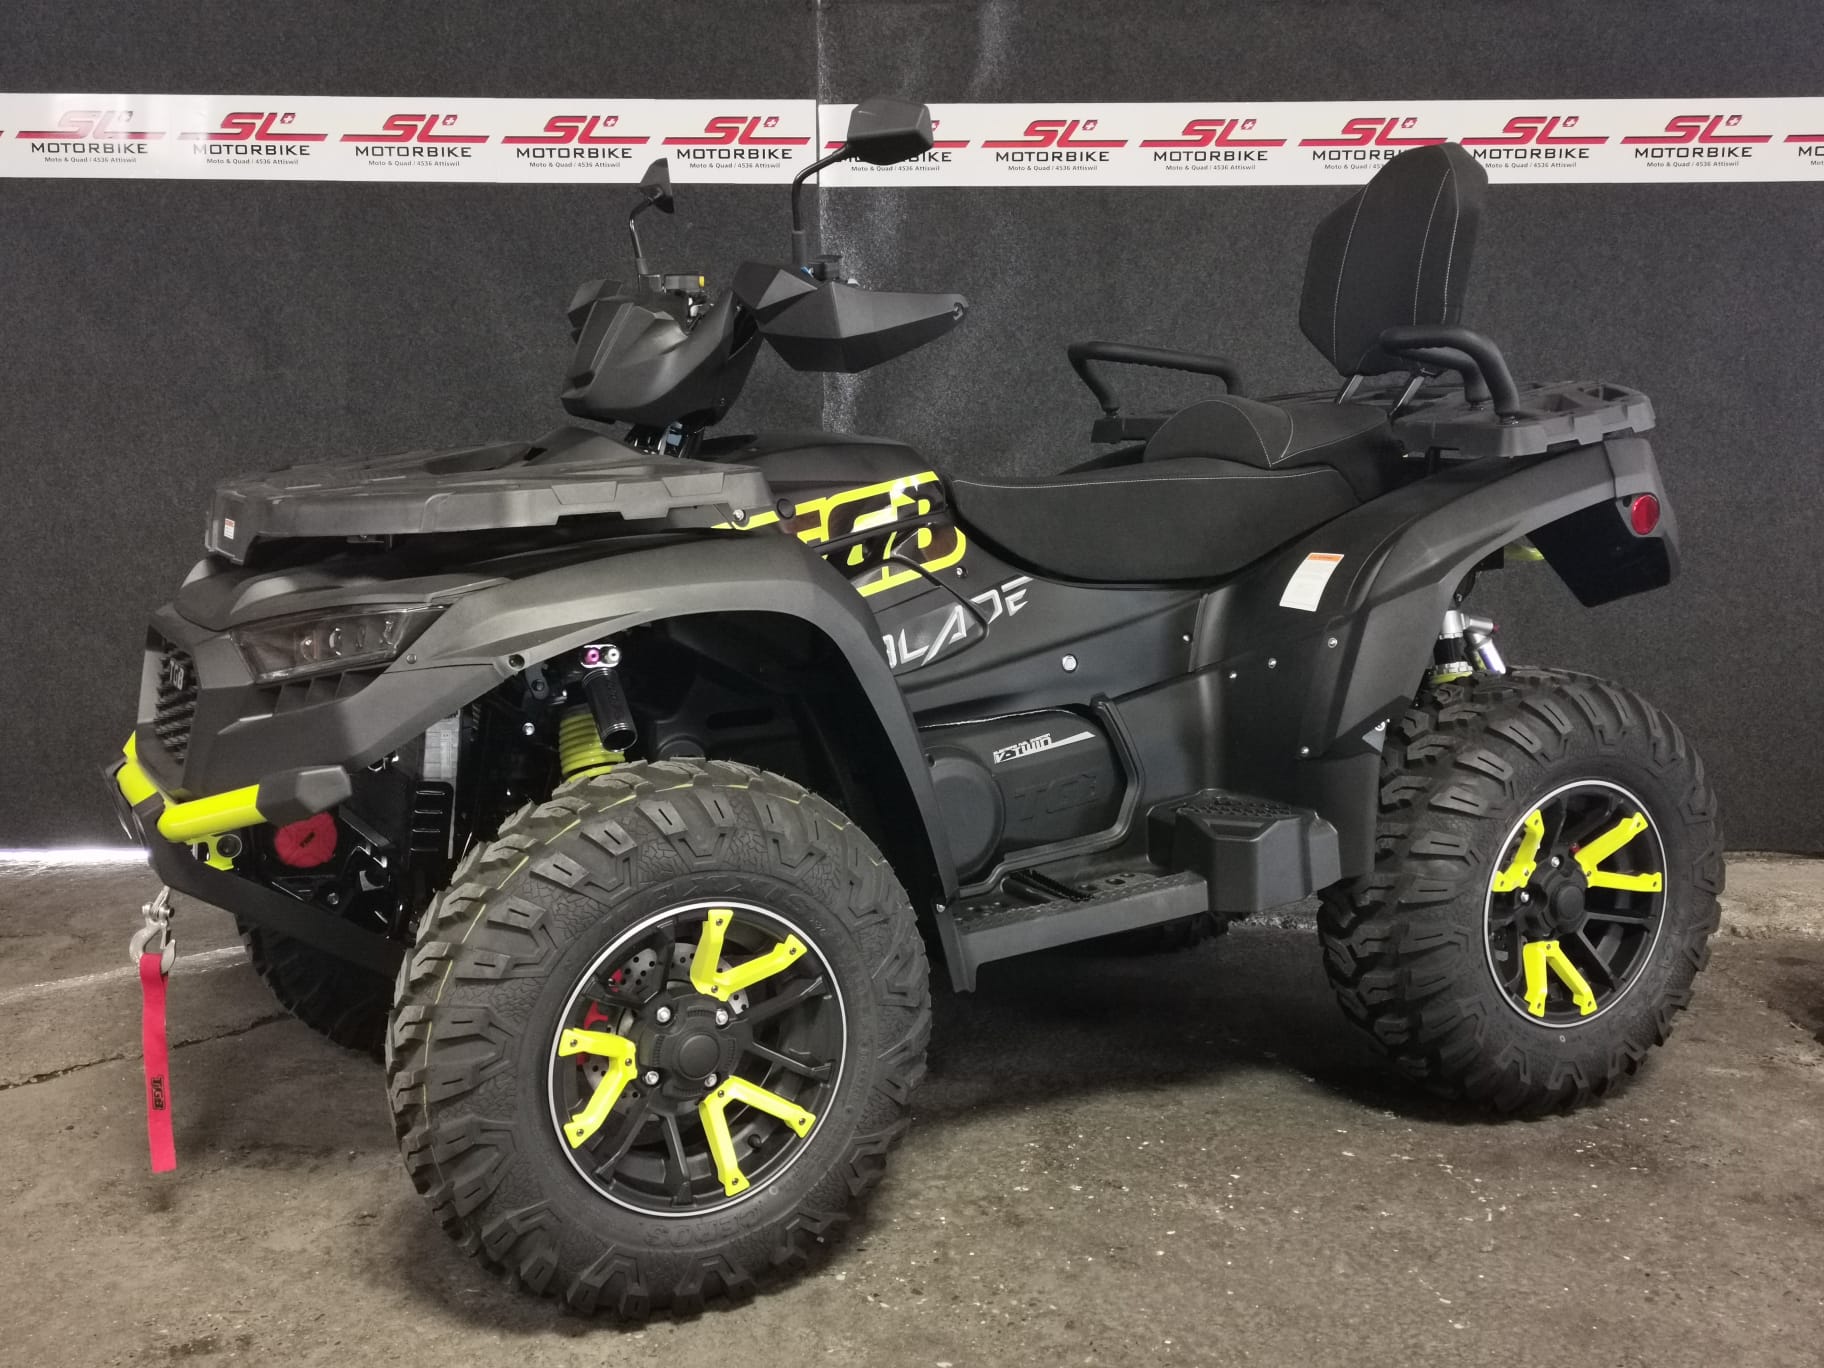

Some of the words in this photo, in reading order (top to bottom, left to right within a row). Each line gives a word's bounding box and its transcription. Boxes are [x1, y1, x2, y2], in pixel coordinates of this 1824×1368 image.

[31, 142, 148, 154] MOTORBIKE
[193, 144, 310, 155] MOTORBIKE
[355, 146, 472, 157] MOTORBIKE
[516, 148, 632, 158] MOTORBIKE
[1472, 148, 1590, 159] MOTORBIKE
[1634, 147, 1752, 158] MOTORBIKE
[677, 149, 792, 159] MOTORBIKE
[996, 151, 1110, 162] MOTORBIKE
[1154, 150, 1268, 161] MOTORBIKE
[1312, 150, 1394, 160] MOTORB
[169, 658, 185, 690] TGB
